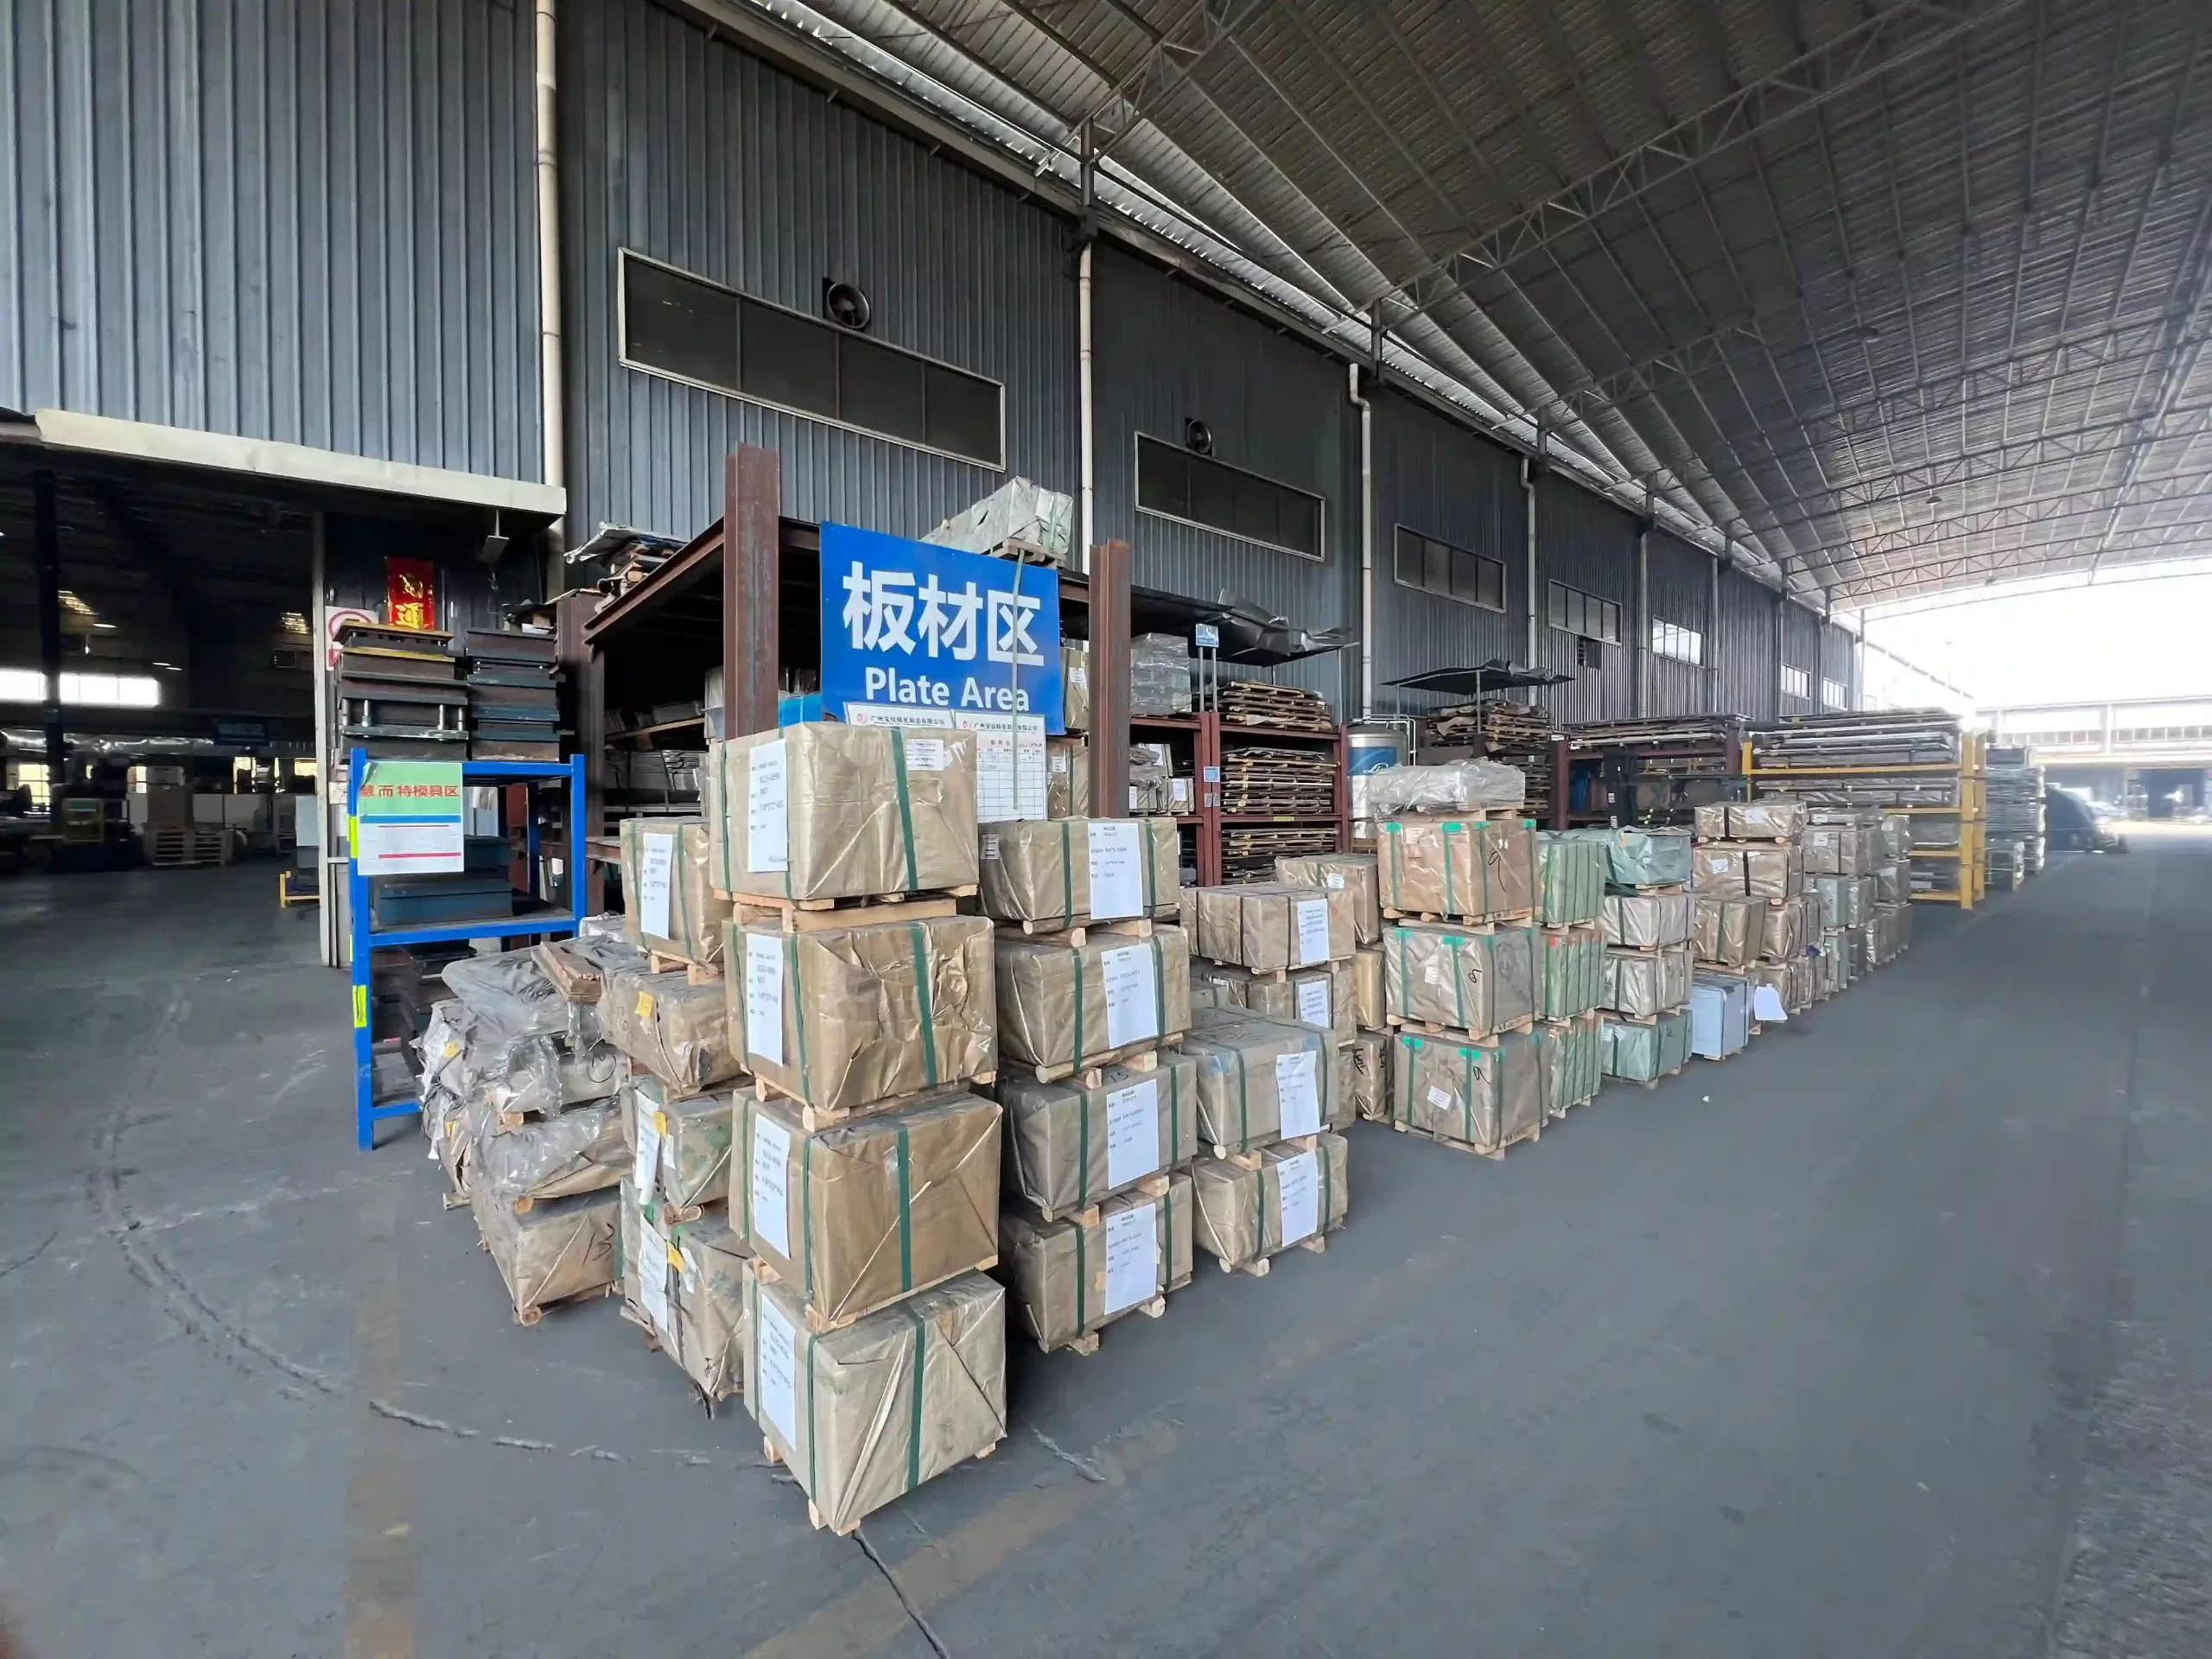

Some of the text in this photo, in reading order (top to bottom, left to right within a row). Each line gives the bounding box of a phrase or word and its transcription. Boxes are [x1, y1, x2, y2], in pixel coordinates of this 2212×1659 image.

[842, 561, 1045, 667] 板材区
[865, 667, 1030, 711] Plate Area
